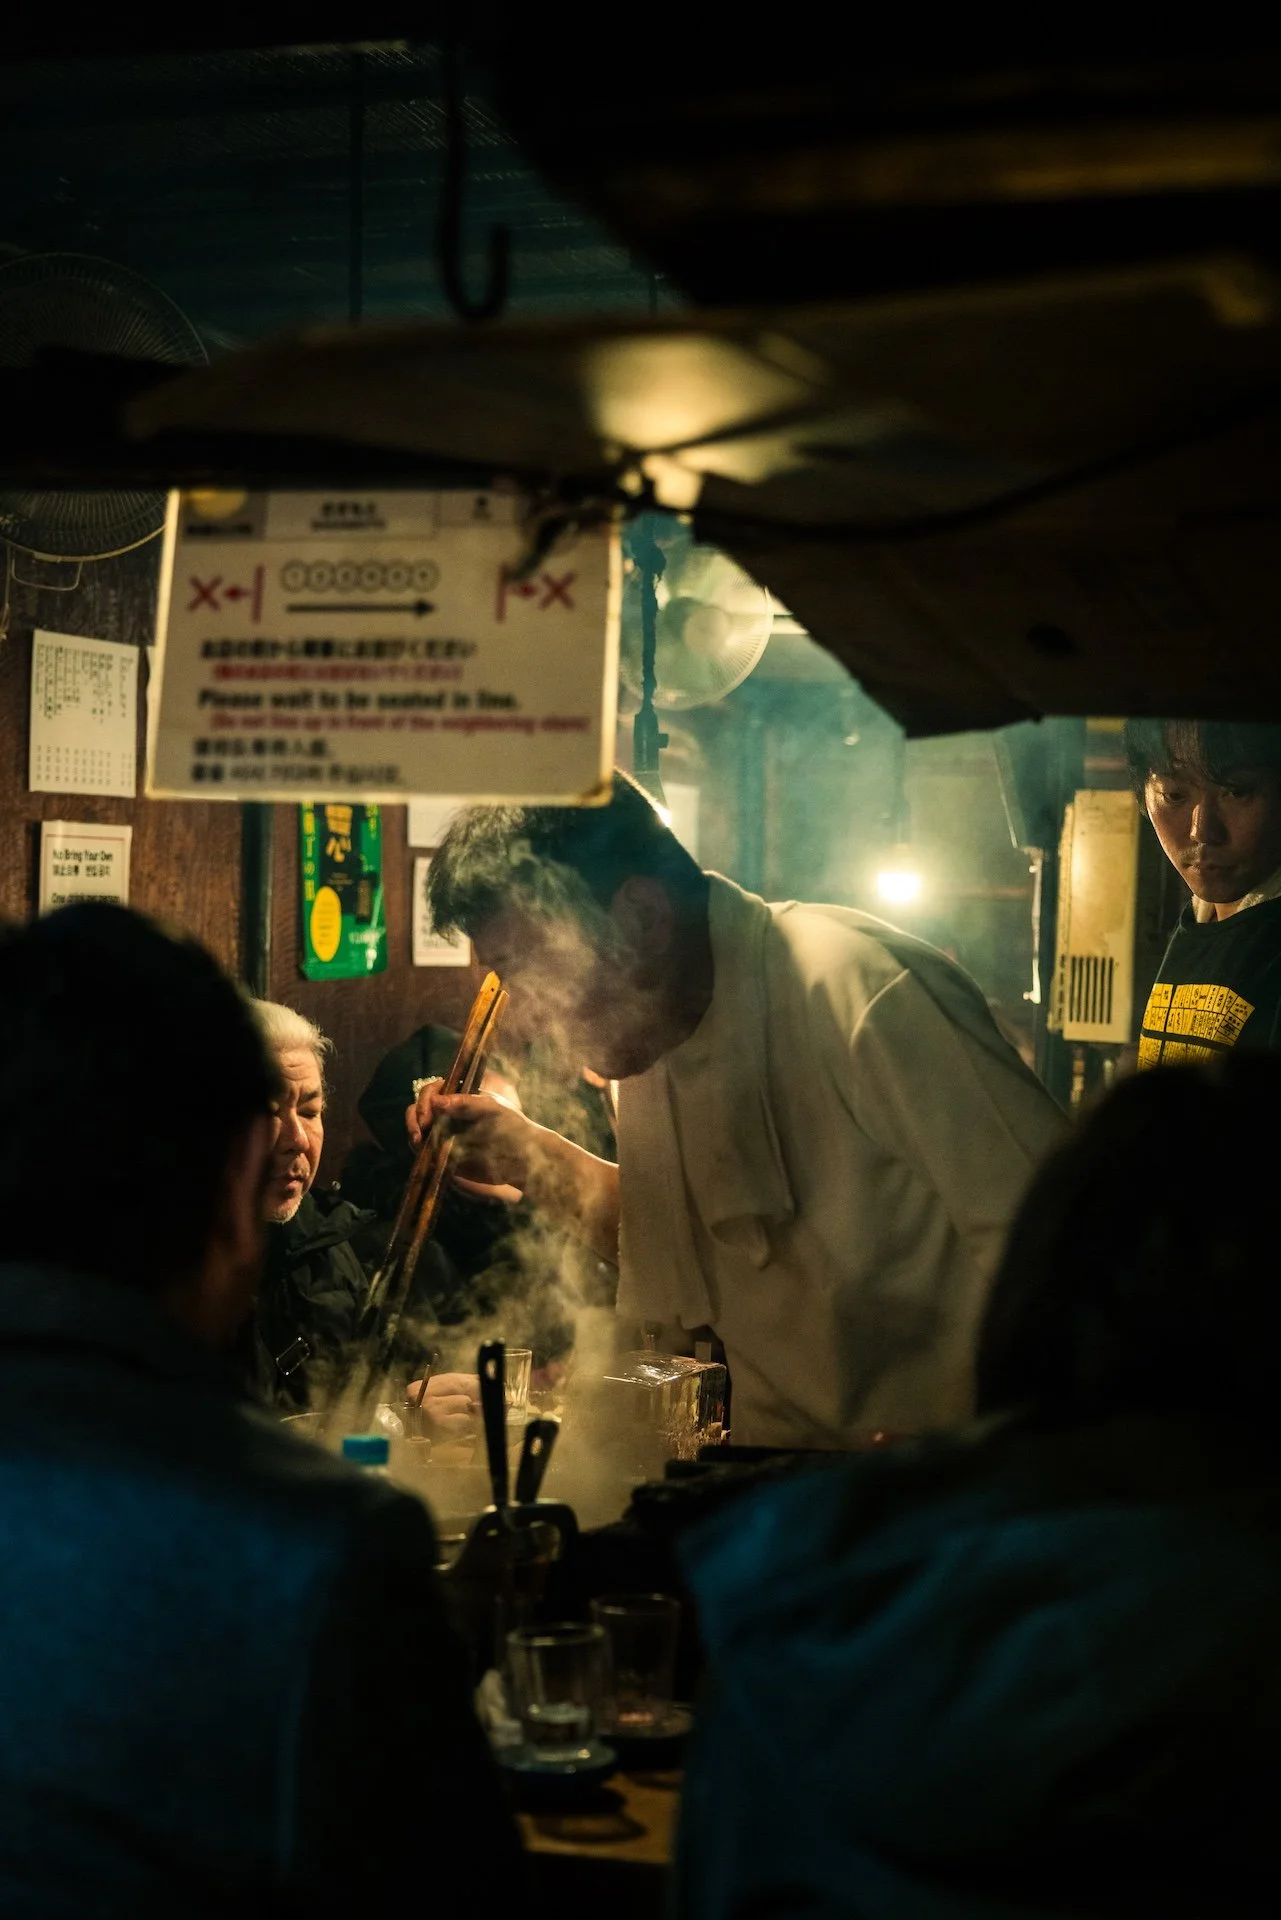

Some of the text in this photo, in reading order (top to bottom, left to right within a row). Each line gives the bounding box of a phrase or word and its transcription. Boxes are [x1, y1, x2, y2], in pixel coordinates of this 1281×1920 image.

[199, 688, 263, 709] Please
[271, 688, 312, 709] wait
[320, 690, 340, 709] to
[345, 688, 371, 709] be
[377, 688, 445, 710] seated
[452, 689, 472, 710] in
[270, 712, 300, 731] line
[304, 714, 325, 734] up
[347, 712, 385, 731] front
[389, 713, 407, 731] of
[409, 713, 435, 731] the
[440, 713, 535, 735] neighboring
[64, 849, 82, 863] Bring
[84, 850, 98, 861] Your
[100, 850, 113, 862] Own
